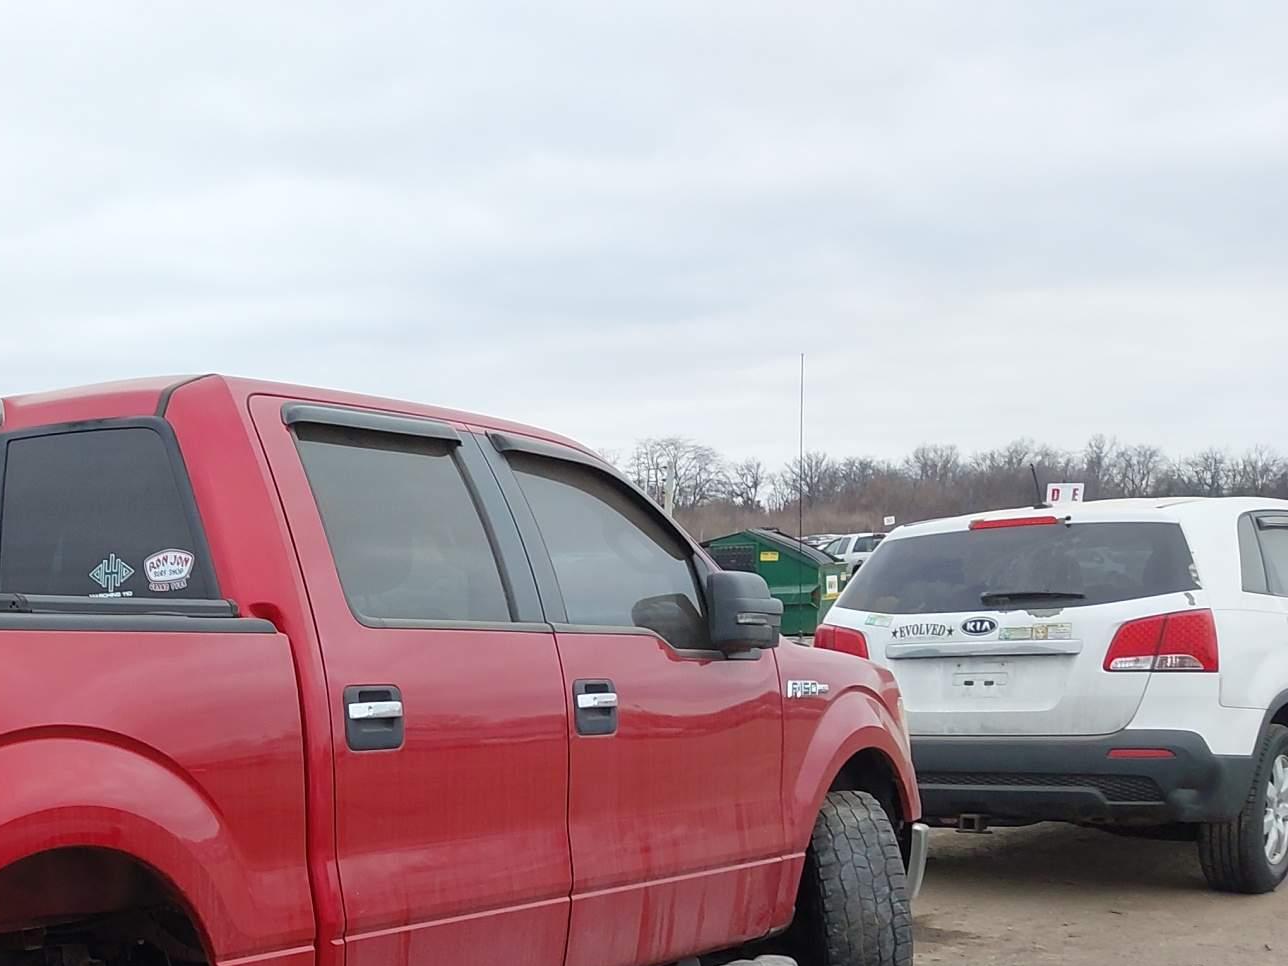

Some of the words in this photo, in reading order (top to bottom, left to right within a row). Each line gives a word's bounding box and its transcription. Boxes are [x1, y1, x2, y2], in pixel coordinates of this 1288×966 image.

[1051, 488, 1060, 502] D
[1072, 488, 1079, 502] E
[149, 555, 168, 572] RON
[170, 554, 190, 567] JON
[899, 623, 946, 638] EVOLVED
[966, 620, 991, 633] KIA
